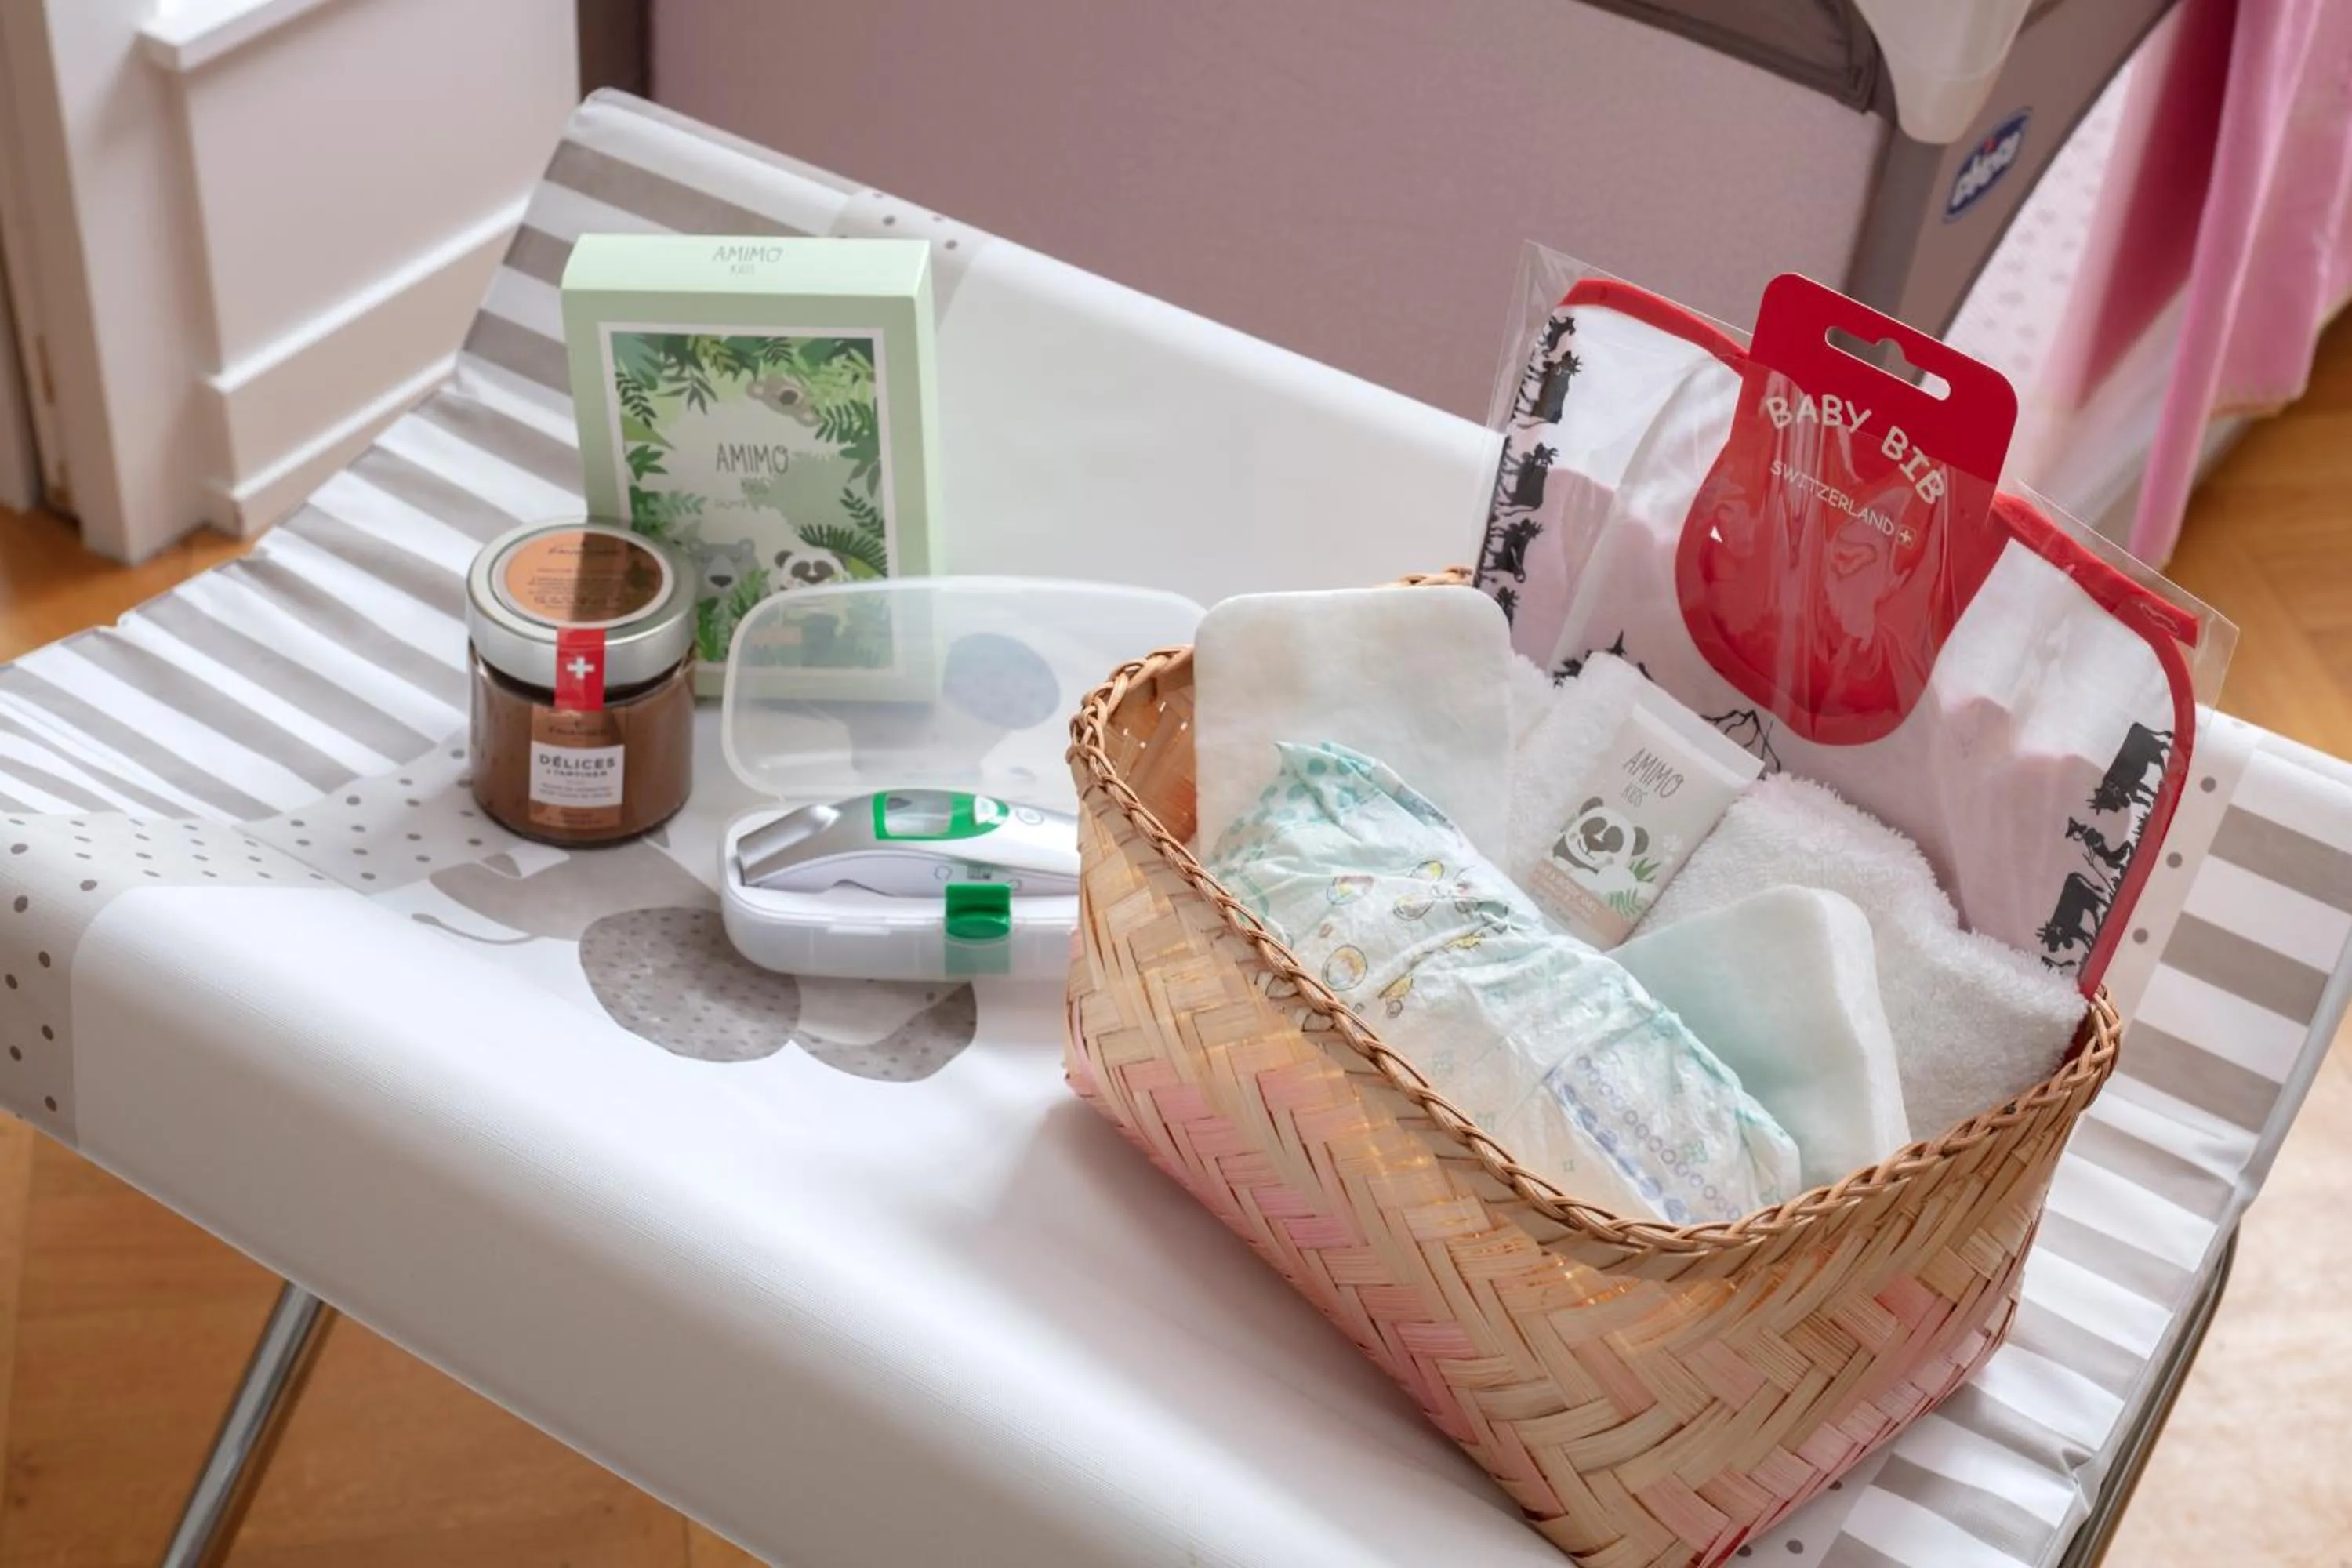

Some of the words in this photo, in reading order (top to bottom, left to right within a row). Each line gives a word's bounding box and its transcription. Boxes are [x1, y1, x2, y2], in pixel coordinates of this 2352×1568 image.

[712, 245, 783, 262] AMIMO
[717, 443, 789, 474] AMIMO
[1766, 394, 1872, 433] BABY
[1882, 426, 1946, 505] BIB
[1769, 459, 1895, 536] SWITZERLAND
[539, 754, 615, 769] DÉLICES
[1622, 746, 1683, 798] AMIMO
